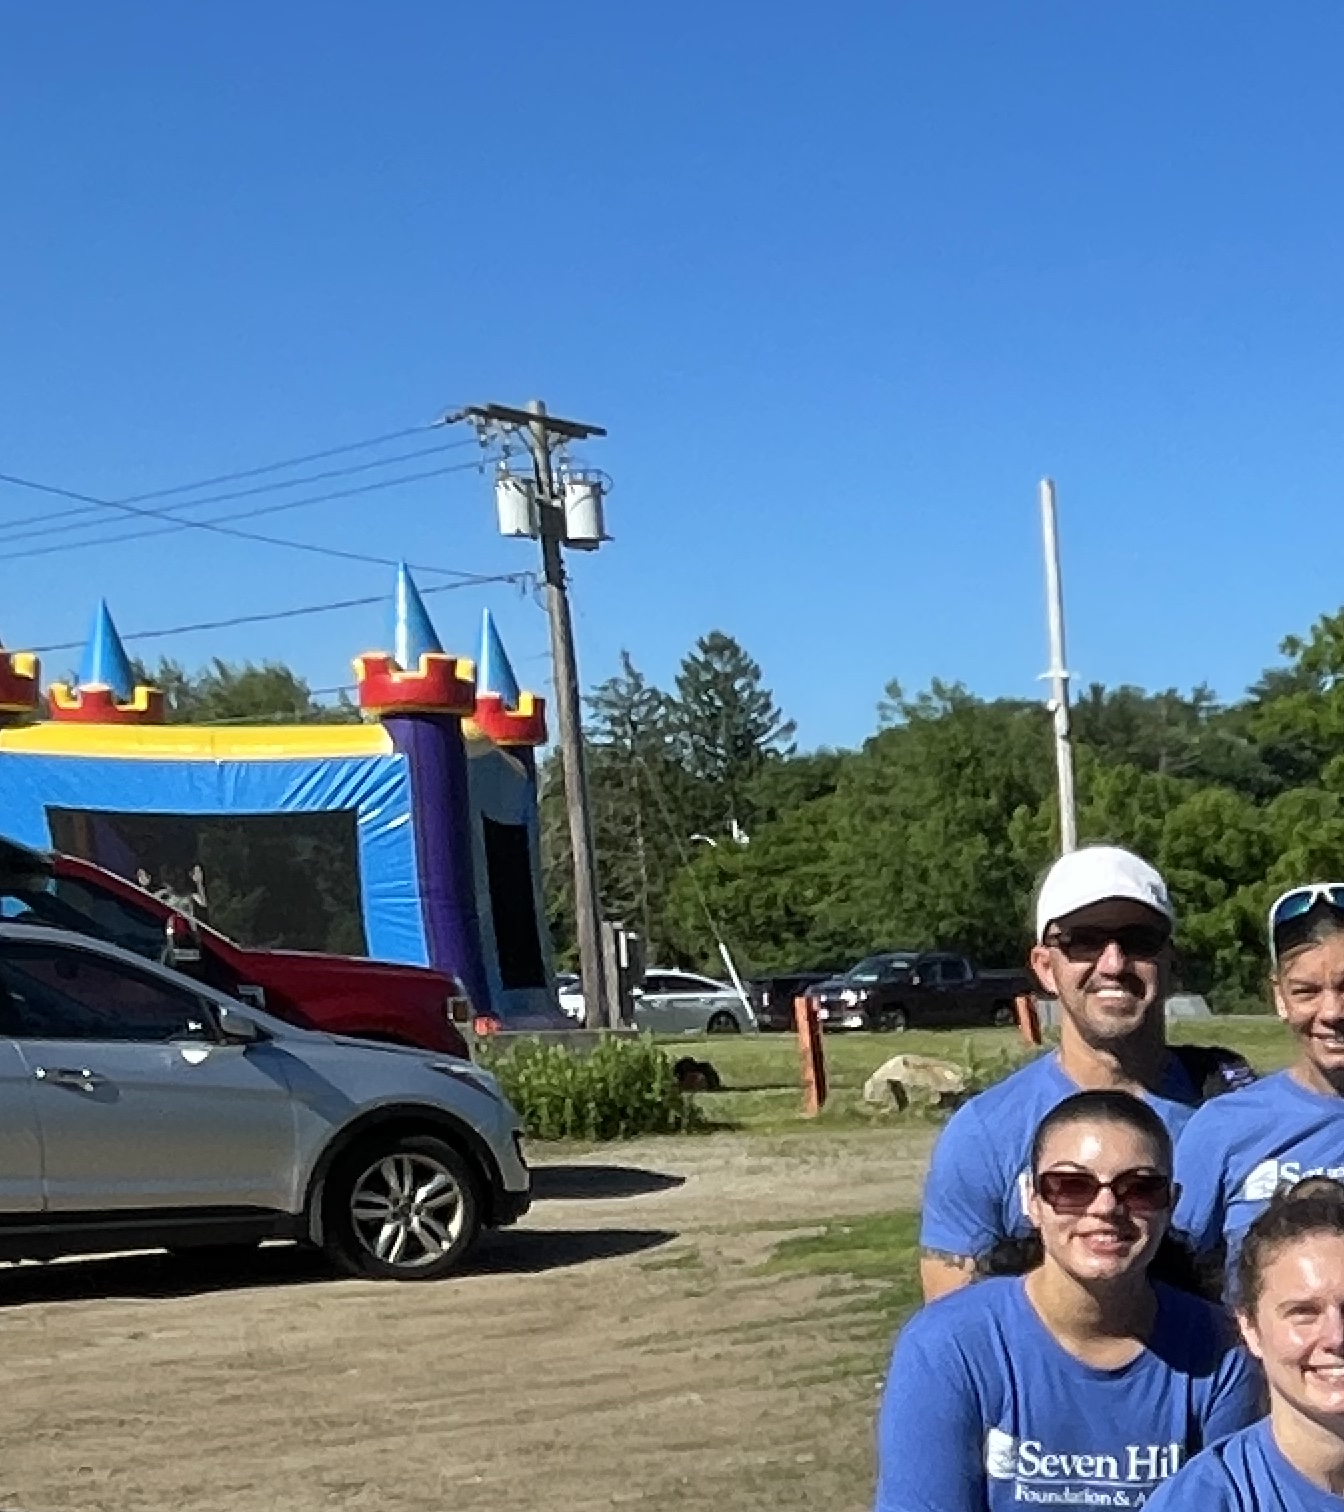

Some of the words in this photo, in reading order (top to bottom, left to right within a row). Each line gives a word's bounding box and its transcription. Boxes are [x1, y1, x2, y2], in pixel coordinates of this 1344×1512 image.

[1017, 1440, 1119, 1480] Seven
[1124, 1442, 1182, 1481] Hil
[1015, 1483, 1112, 1507] Foundation
[1112, 1489, 1131, 1507] &
